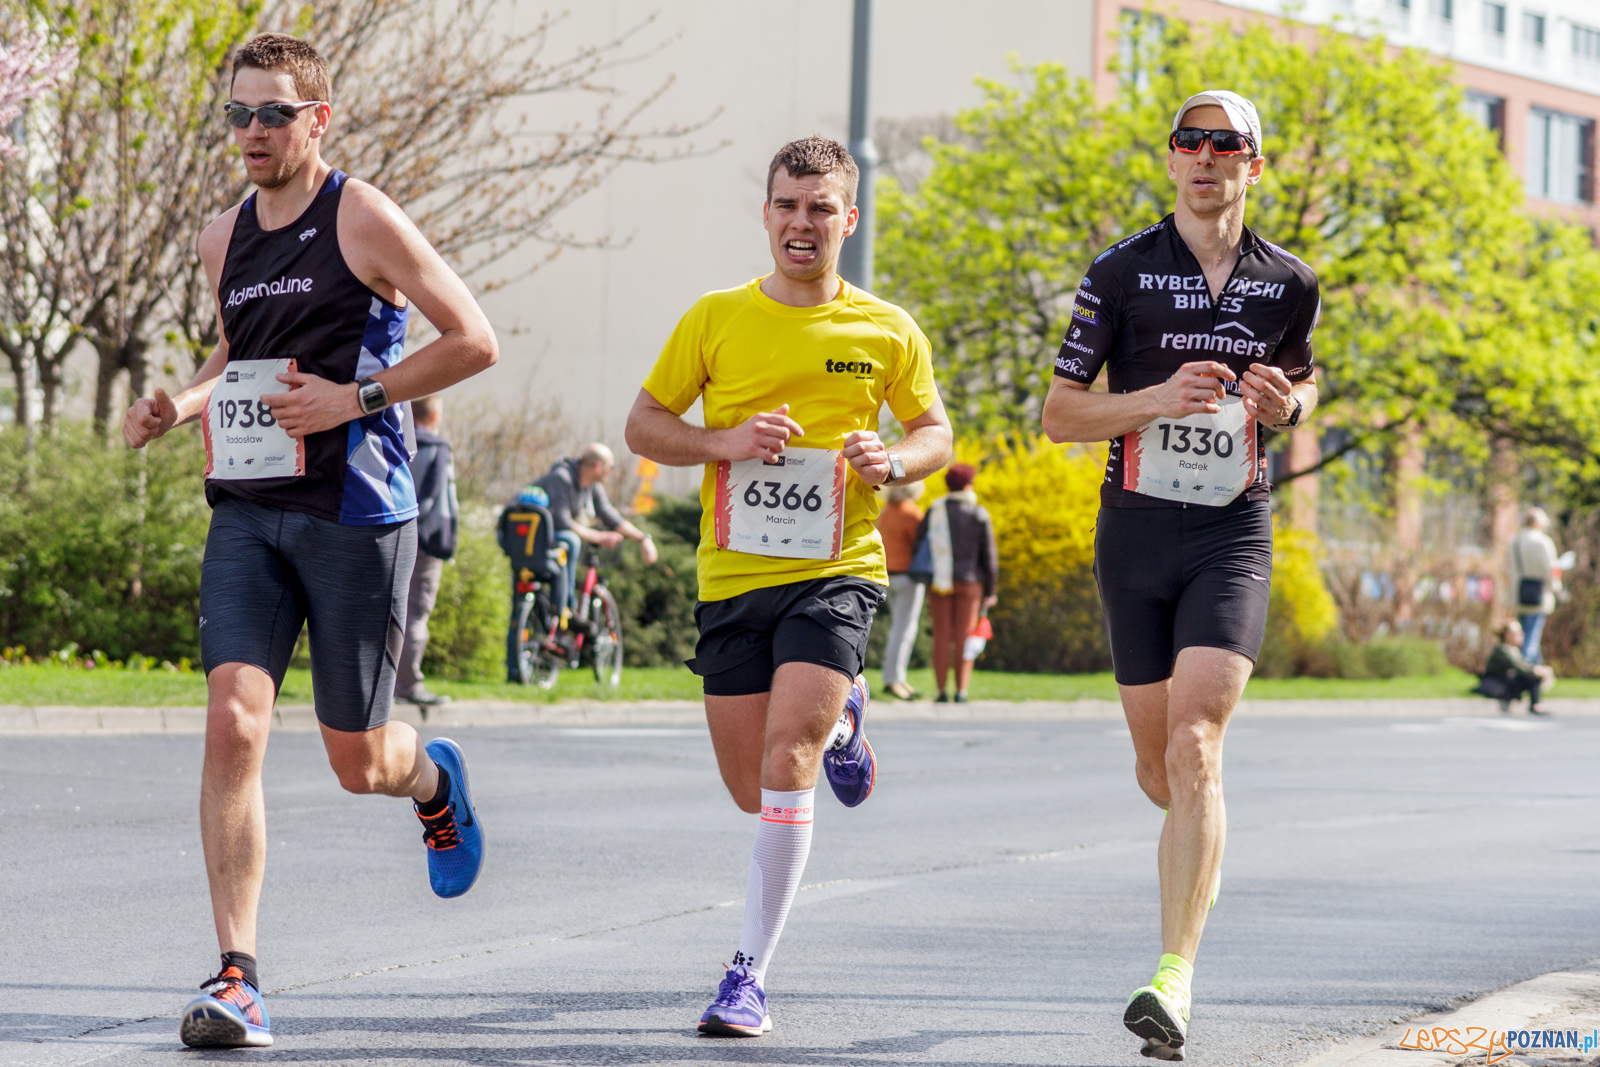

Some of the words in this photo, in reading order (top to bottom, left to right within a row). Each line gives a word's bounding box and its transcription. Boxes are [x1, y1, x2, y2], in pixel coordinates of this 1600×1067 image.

[1160, 333, 1267, 358] remmers
[825, 359, 872, 374] team
[218, 400, 276, 428] 1938
[226, 435, 263, 444] Radosław
[1158, 423, 1234, 458] 1330
[1179, 460, 1208, 471] Radek
[744, 480, 822, 512] 6366
[766, 515, 796, 525] Marcin
